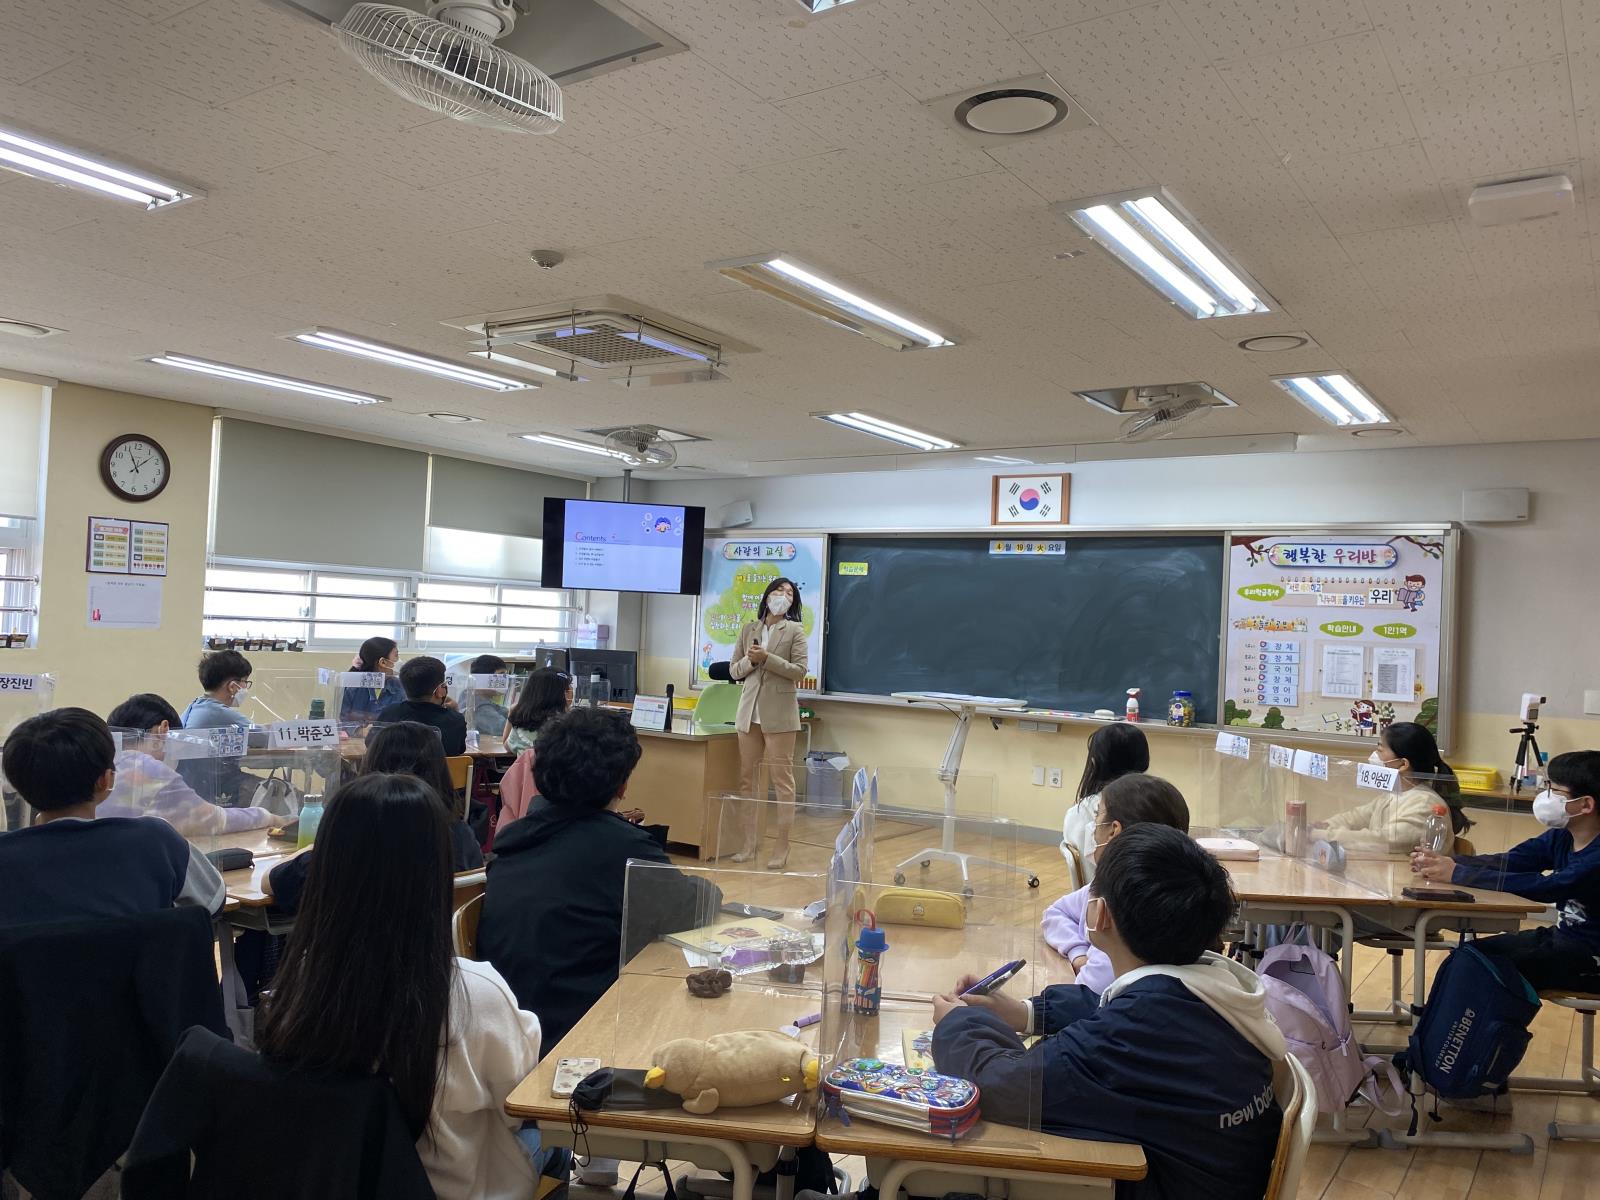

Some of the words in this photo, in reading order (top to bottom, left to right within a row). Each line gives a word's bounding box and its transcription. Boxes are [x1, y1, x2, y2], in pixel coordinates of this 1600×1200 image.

[115, 451, 124, 459] 10
[575, 532, 607, 542] Contents
[734, 546, 760, 556] 사랑의
[766, 546, 784, 557] 교실
[1016, 543, 1024, 551] 19
[1026, 543, 1032, 551] 일
[1048, 543, 1062, 552] 요일
[1283, 547, 1326, 562] 행복한
[1333, 548, 1376, 564] 우리반
[1349, 596, 1365, 606] 키우는
[1371, 589, 1391, 604] 우리
[1328, 624, 1356, 633] 학습안내
[1384, 626, 1407, 635] 1인1역
[1440, 1017, 1472, 1074] BENETTON
[1220, 1102, 1254, 1129] new
